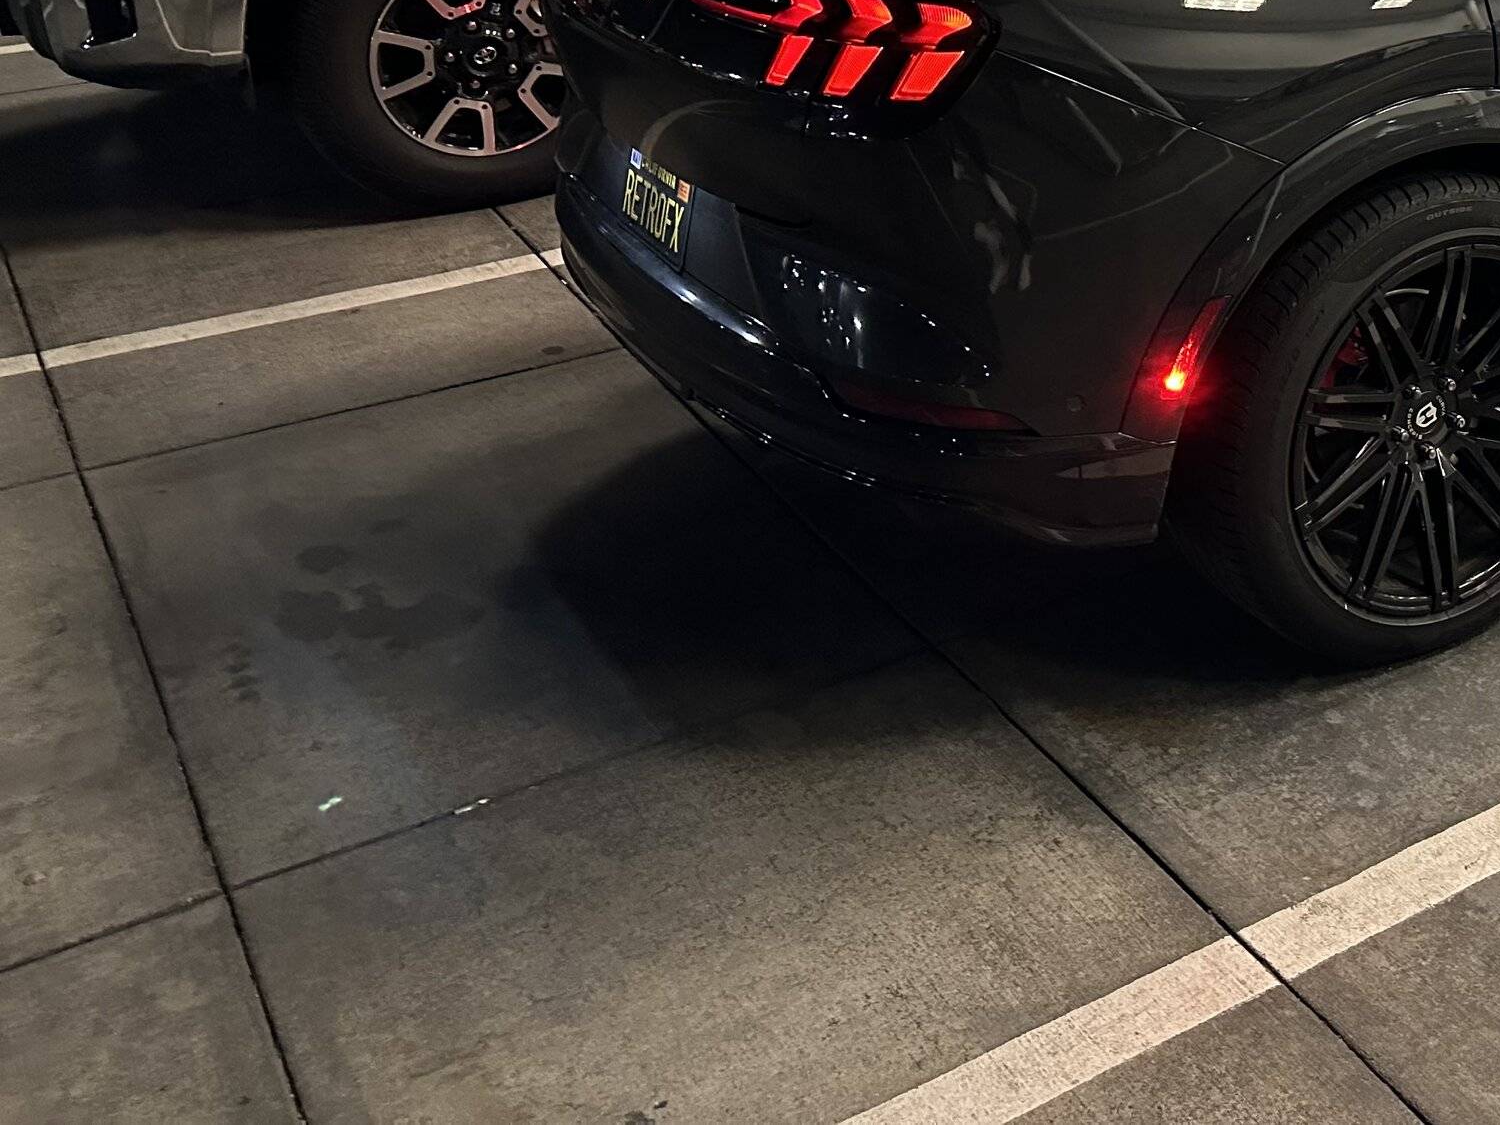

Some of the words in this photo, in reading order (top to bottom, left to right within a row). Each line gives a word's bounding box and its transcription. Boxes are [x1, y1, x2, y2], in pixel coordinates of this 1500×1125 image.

[622, 168, 685, 253] RETROFX
[1425, 204, 1474, 221] OUTSIDE
[1435, 395, 1447, 417] CURVA
